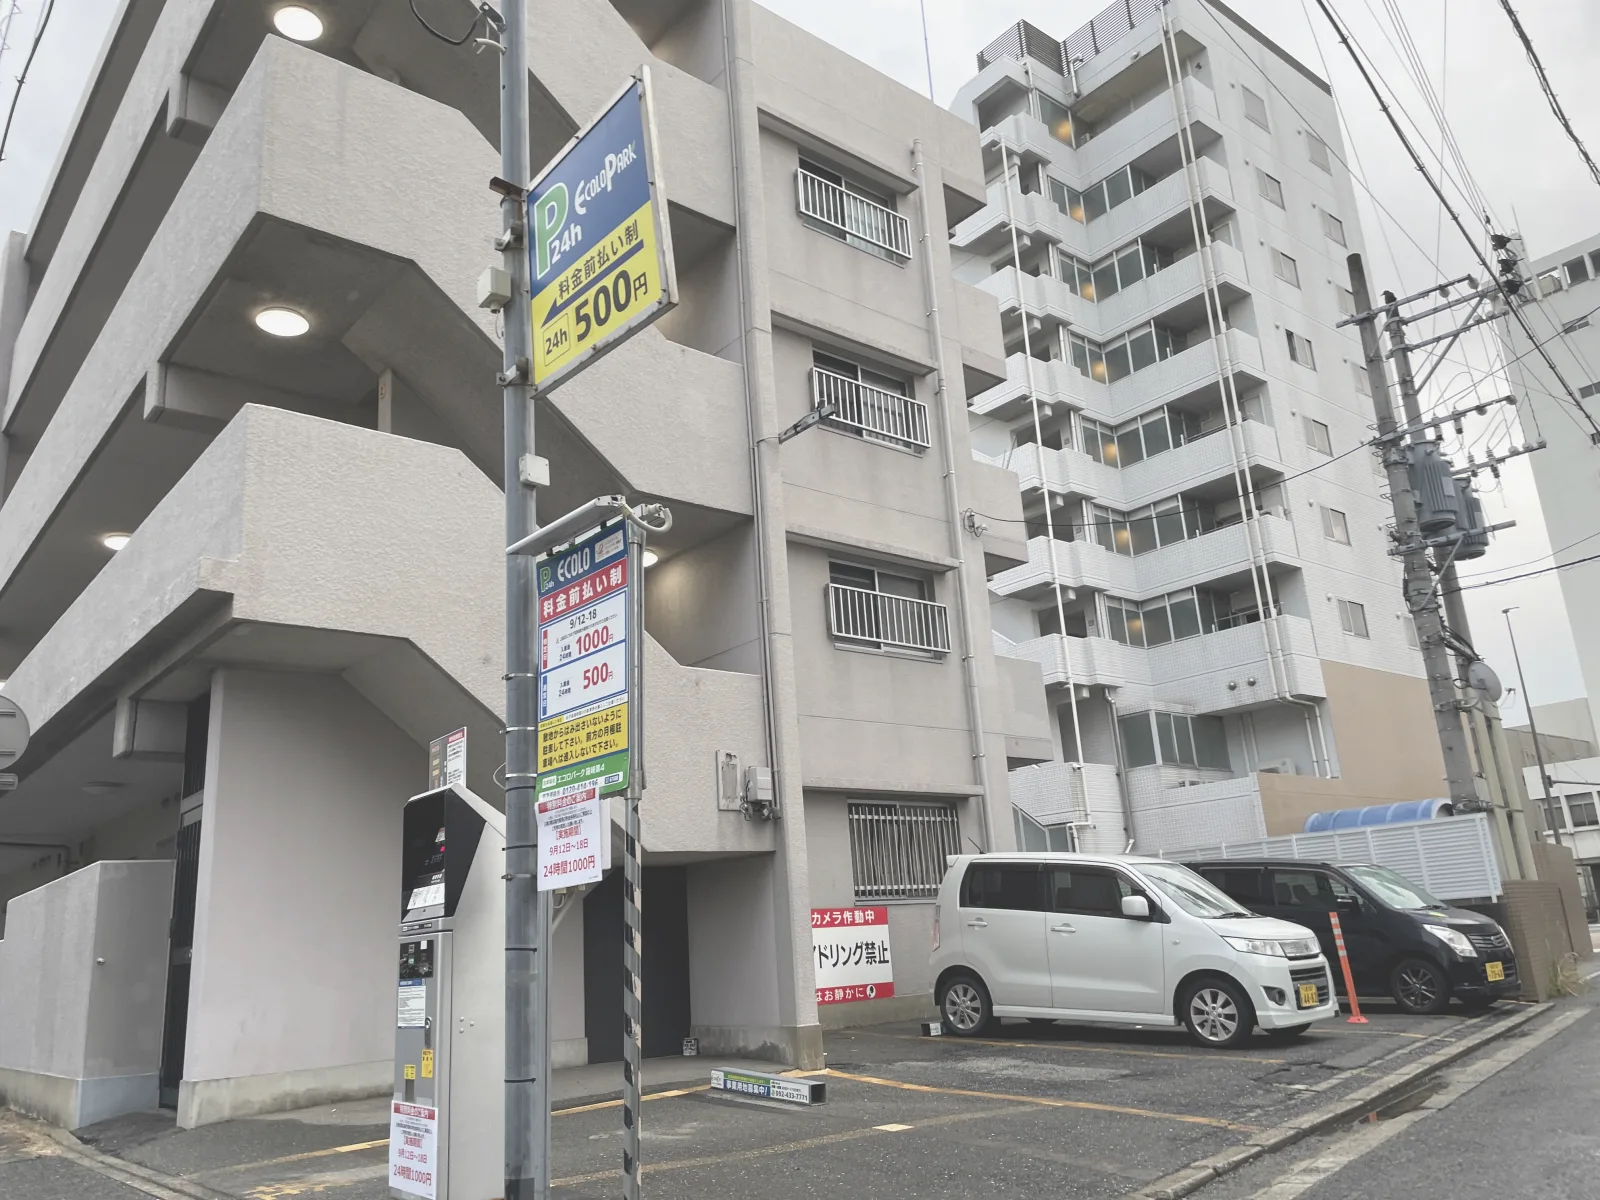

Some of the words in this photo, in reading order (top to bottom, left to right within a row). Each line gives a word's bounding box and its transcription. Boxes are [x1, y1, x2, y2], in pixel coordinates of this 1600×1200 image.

[534, 182, 569, 281] P
[550, 222, 583, 264] 24h
[558, 219, 639, 300] 料金前払い制
[545, 327, 568, 356] 24h
[574, 268, 649, 343] 500円
[557, 547, 590, 582] ECOLO
[543, 565, 622, 618] 料金前払い制
[576, 625, 613, 655] 1000円
[583, 662, 613, 689] 500円
[543, 855, 595, 877] 24時間1000円
[812, 909, 875, 925] カメラ作動中
[393, 1164, 432, 1186] 24時間1000円
